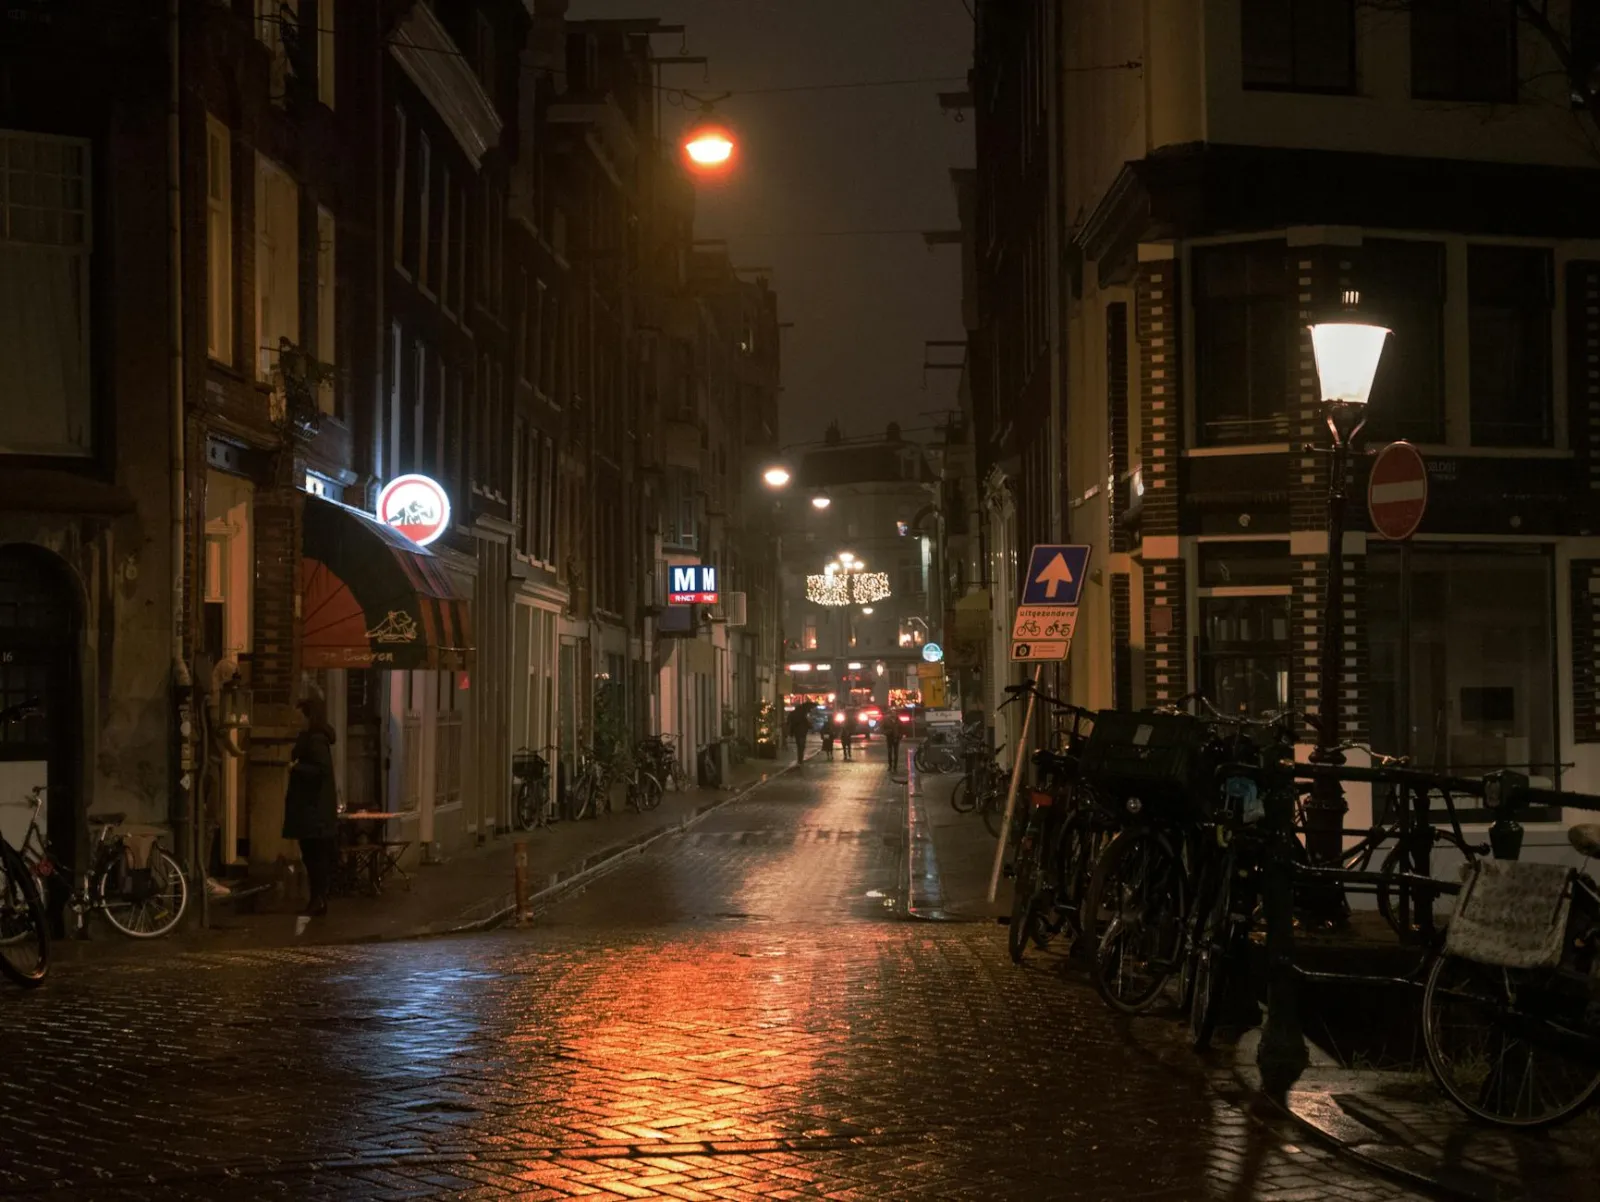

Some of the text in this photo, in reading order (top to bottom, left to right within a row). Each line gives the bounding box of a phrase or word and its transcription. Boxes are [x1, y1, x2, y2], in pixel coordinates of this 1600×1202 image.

[674, 567, 696, 592] M
[702, 567, 715, 592] M
[1019, 610, 1076, 618] uitgezonderd
